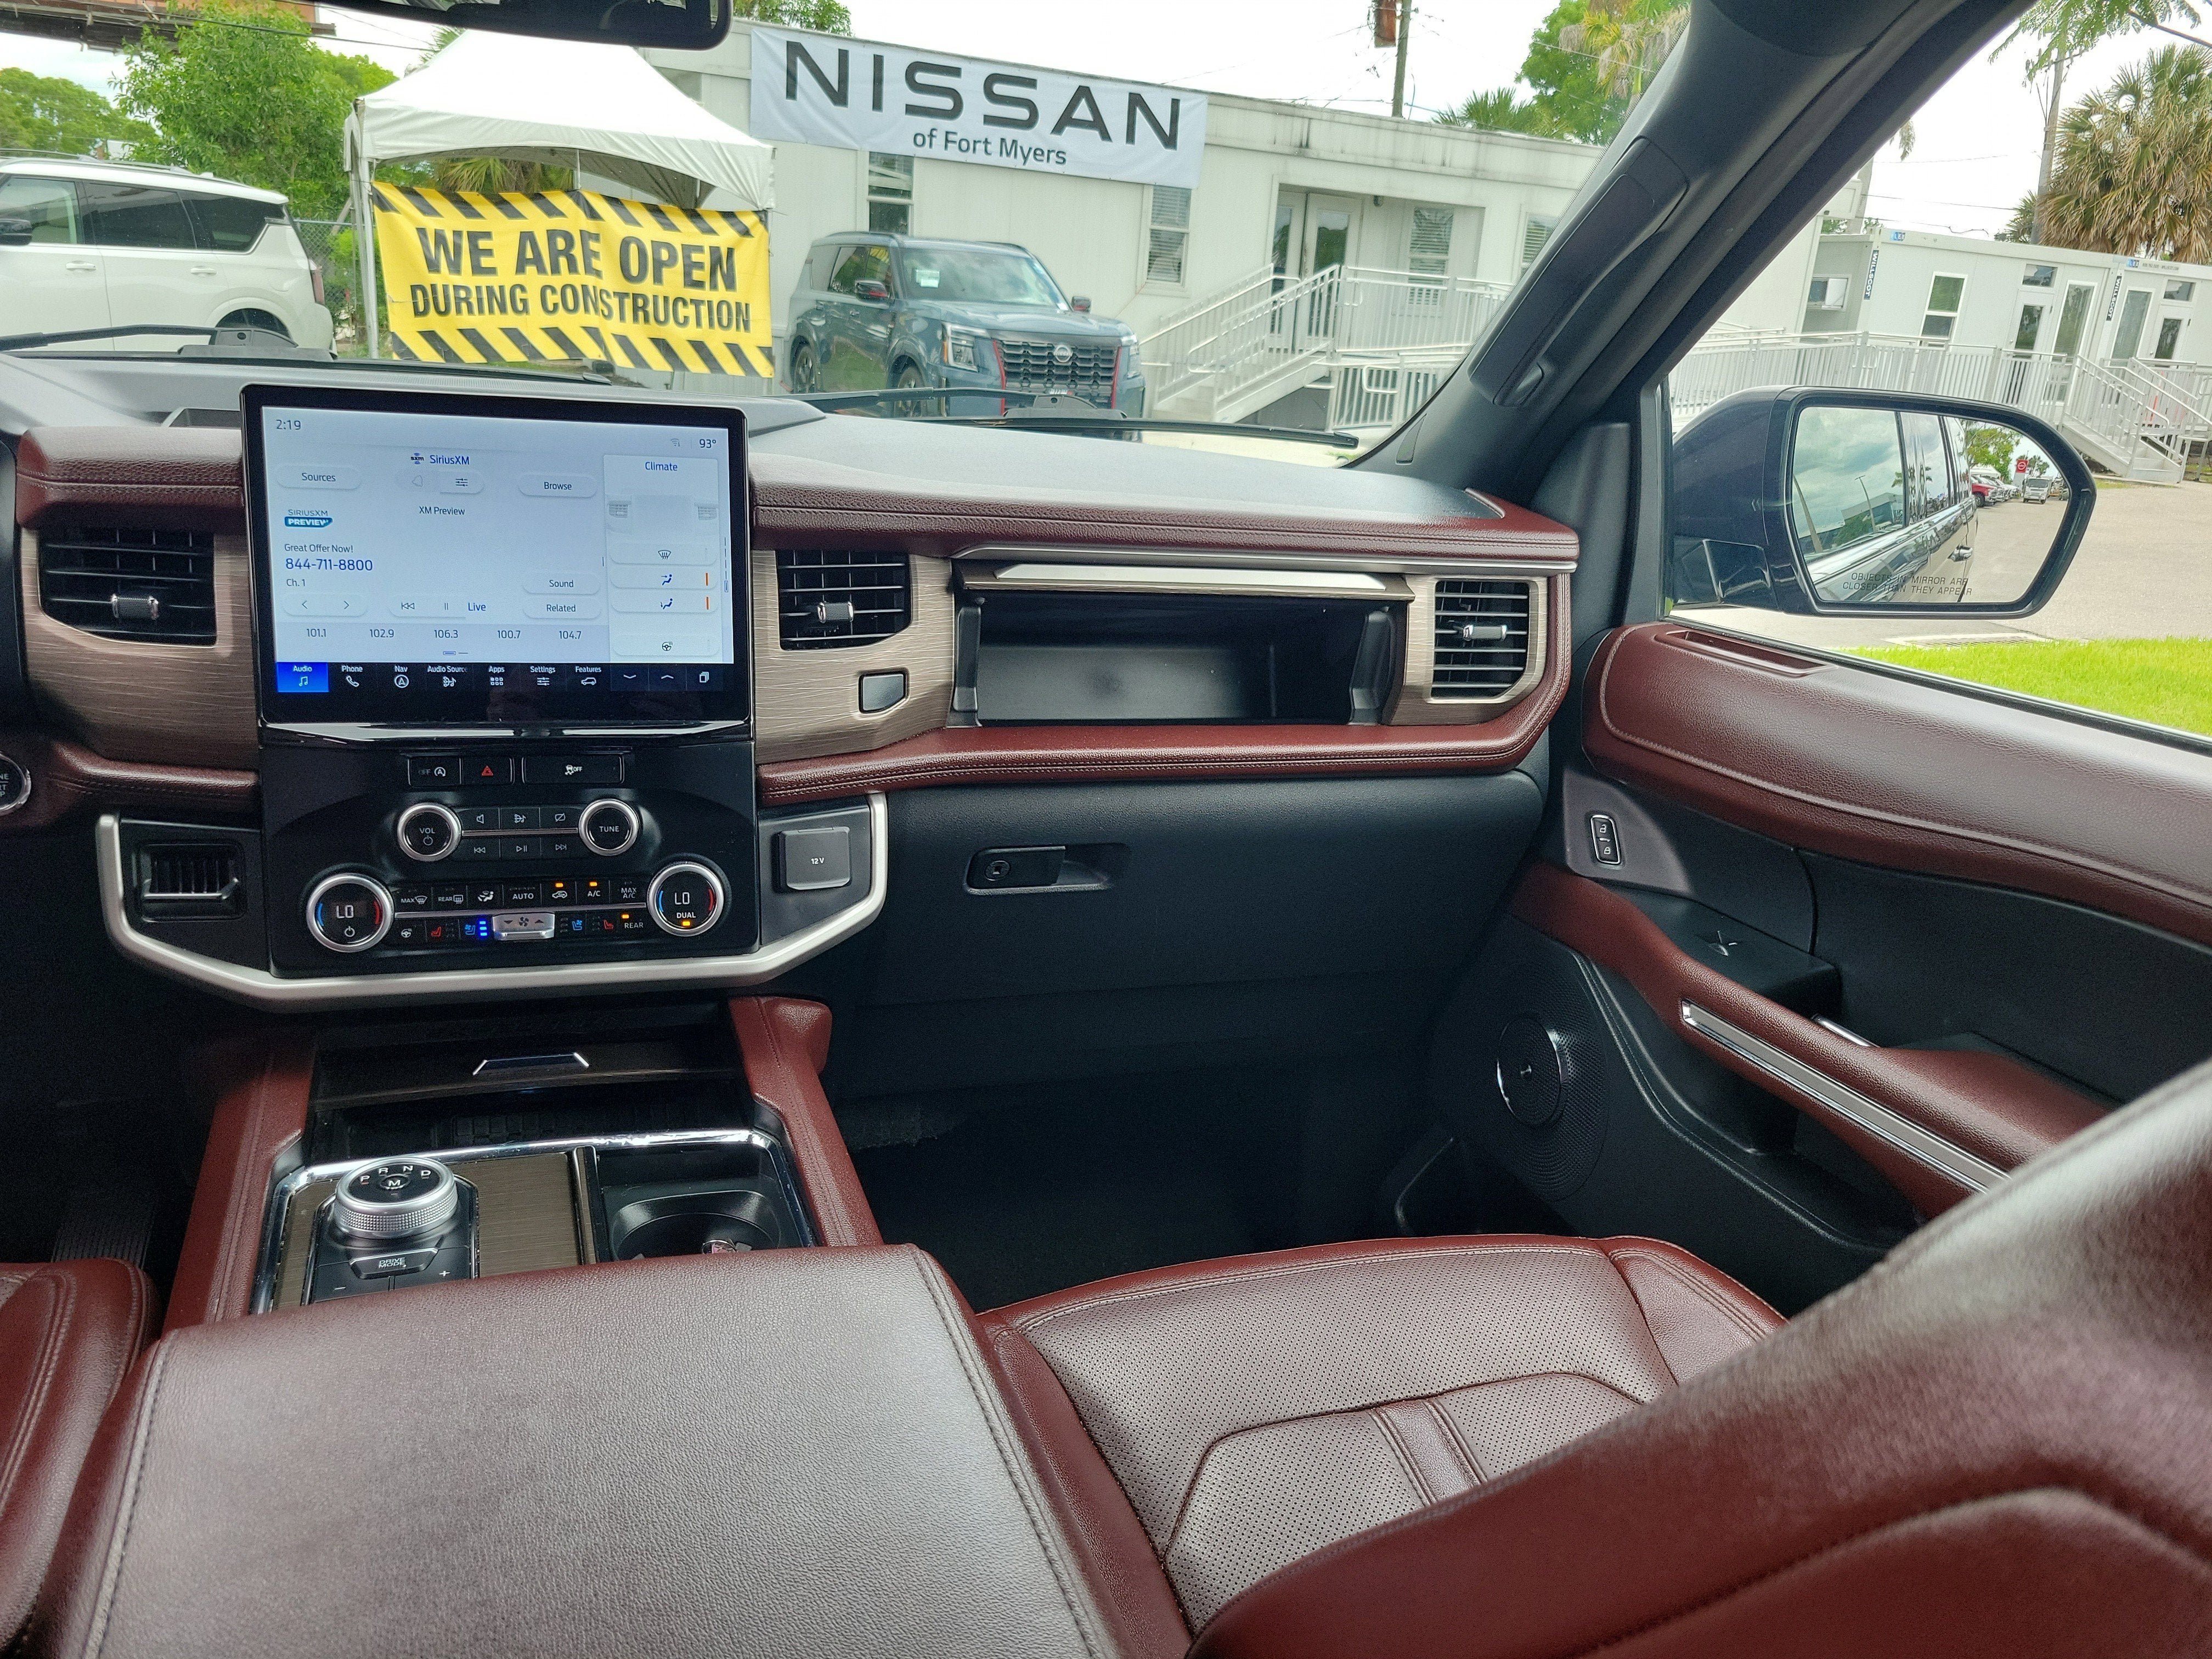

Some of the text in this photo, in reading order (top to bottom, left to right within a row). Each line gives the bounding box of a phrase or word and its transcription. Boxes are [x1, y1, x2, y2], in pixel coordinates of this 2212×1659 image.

[786, 41, 1181, 151] NISSAN
[913, 128, 1066, 166] of Fort Myers
[416, 227, 737, 292] WE ARE OPEN
[1865, 252, 1878, 297] WILLSCOT
[2108, 278, 2122, 319] WILLSCOT
[410, 284, 751, 334] DURING CONSTRUCTION
[276, 420, 301, 431] 2:19
[699, 438, 717, 449] 93°
[430, 455, 470, 465] SiriusXM
[645, 461, 678, 472] Climate
[302, 472, 336, 482] Sources
[544, 482, 572, 490] Browse
[419, 506, 465, 516] XM Preview
[289, 518, 329, 527] PREVIEW
[285, 544, 354, 553] Great Offer Now!
[286, 558, 374, 572] 844-711-8800
[286, 579, 306, 587] Ch. 1
[1851, 572, 1892, 582] OBJECTS
[1911, 576, 1946, 585] MIRROR
[1842, 582, 1972, 596] CLOSER THAN THEY APPEAR
[468, 602, 486, 611] Live
[546, 604, 576, 612] Related
[306, 628, 327, 637] 101.1
[370, 629, 394, 638] 102.9
[434, 629, 459, 639] 106.3
[498, 630, 521, 639] 100.7
[559, 630, 582, 640] 104.7
[530, 665, 556, 674] Settings
